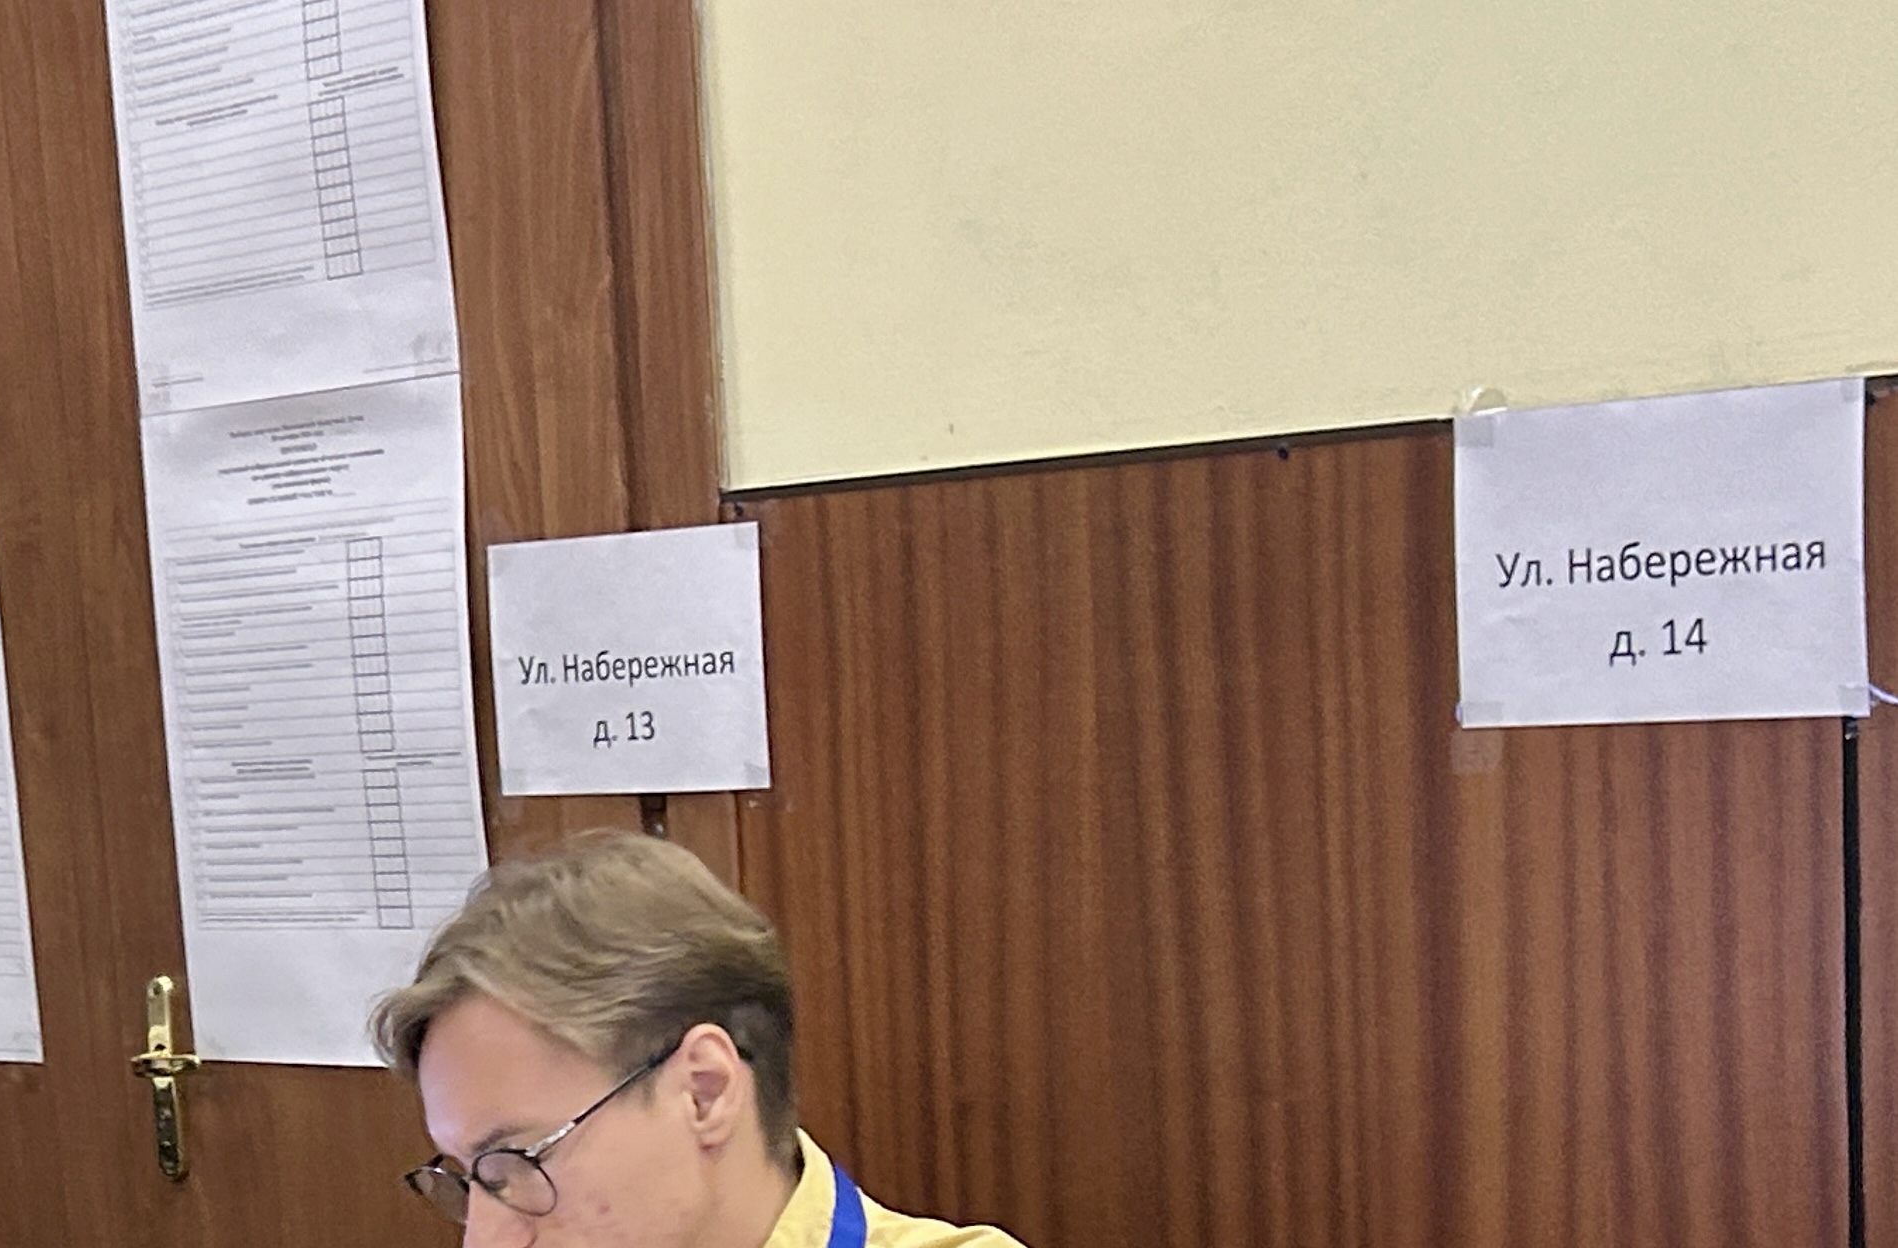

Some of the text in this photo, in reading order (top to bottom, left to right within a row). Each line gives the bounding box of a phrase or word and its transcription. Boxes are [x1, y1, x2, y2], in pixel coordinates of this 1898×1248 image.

[1495, 540, 1827, 588] Ул. Набережная
[1609, 617, 1708, 667] д. 14
[518, 650, 735, 687] Ул. Набережная
[593, 711, 655, 748] д. 13
